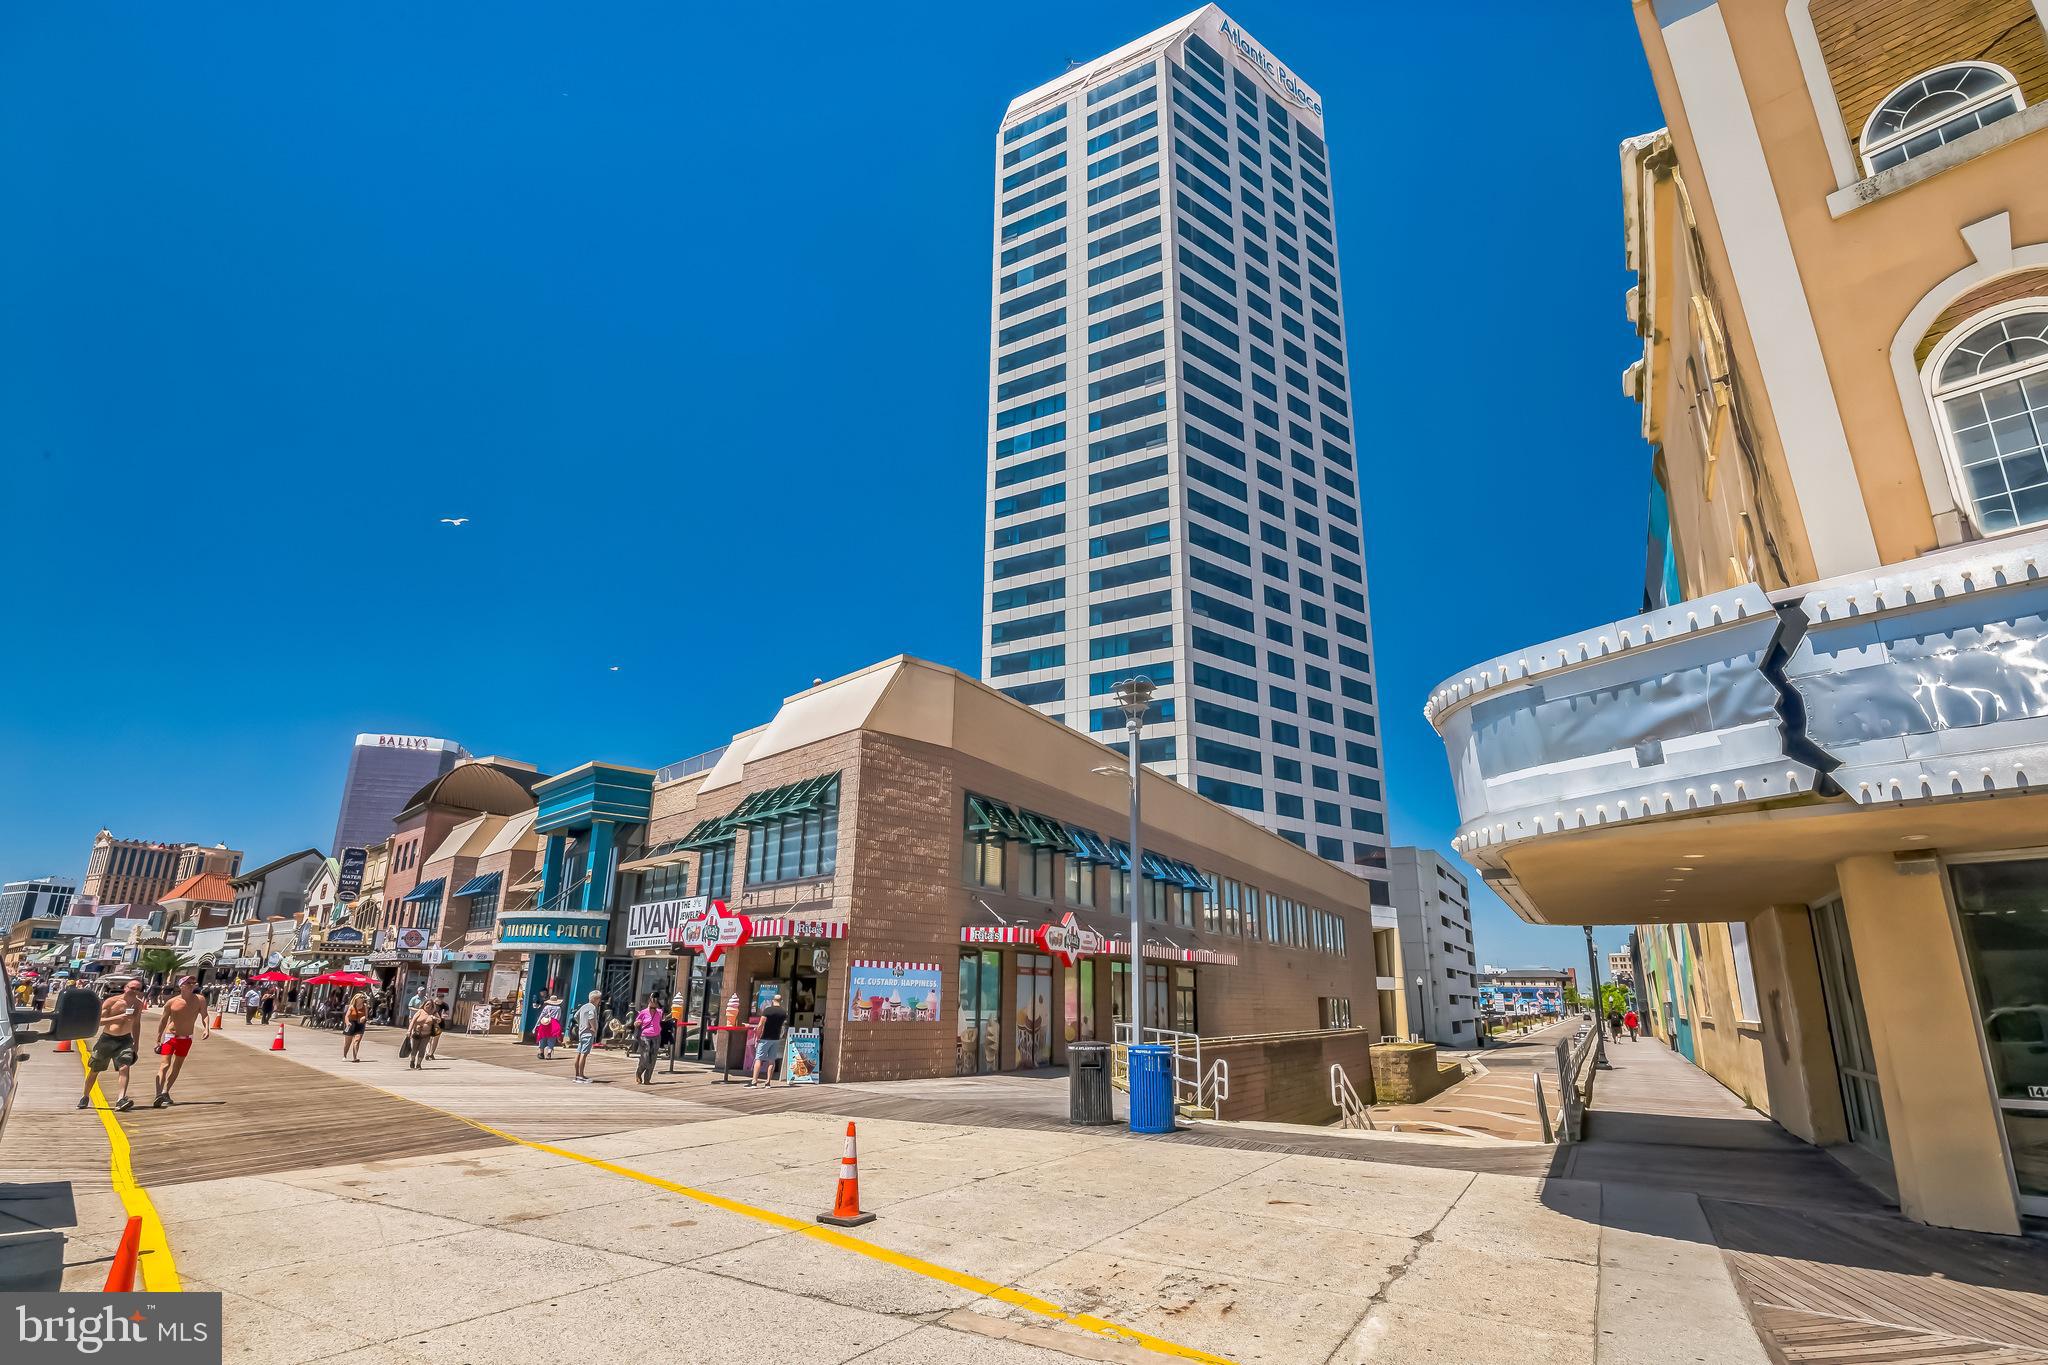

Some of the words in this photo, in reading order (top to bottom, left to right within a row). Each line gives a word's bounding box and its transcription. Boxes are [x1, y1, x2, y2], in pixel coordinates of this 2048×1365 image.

[1219, 19, 1275, 75] Atlantic
[1277, 66, 1322, 117] Palace
[630, 901, 680, 936] LIVANI
[506, 923, 551, 937] ATLANTIC
[556, 924, 602, 939] PALACE
[797, 922, 824, 935] Rita's
[974, 929, 1001, 941] Rita's
[2030, 1086, 2048, 1097] 14
